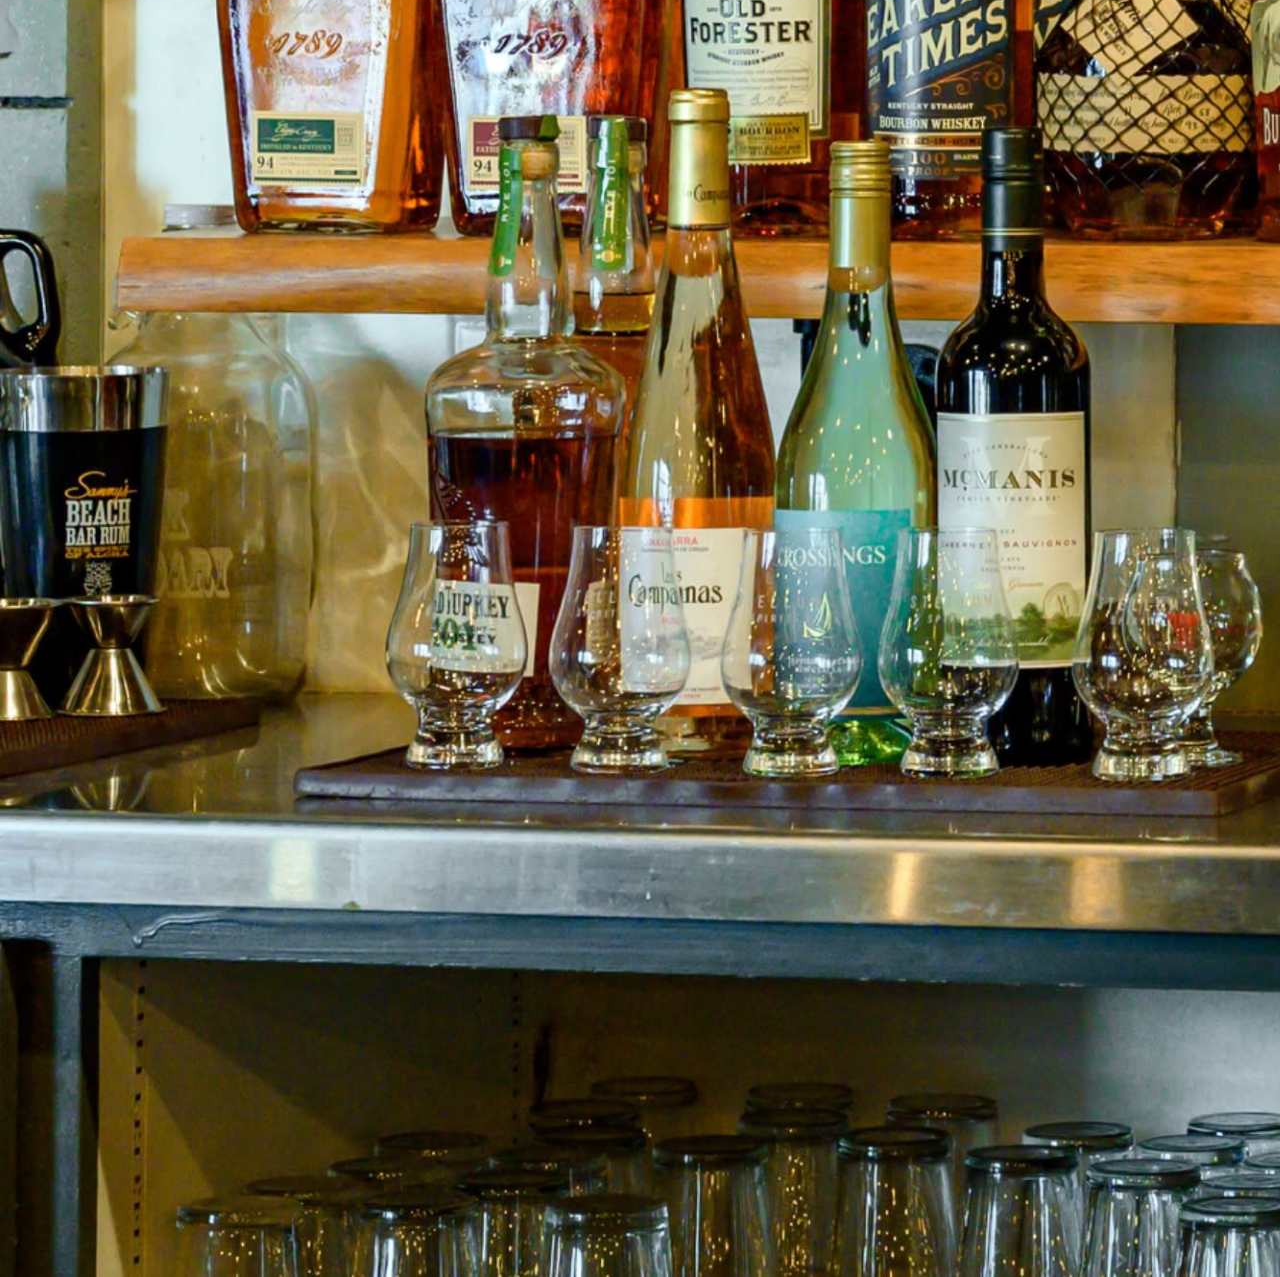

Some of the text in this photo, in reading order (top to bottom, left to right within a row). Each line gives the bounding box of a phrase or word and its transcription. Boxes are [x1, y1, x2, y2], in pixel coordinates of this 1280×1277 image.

[690, 17, 811, 44] FORESTER
[266, 28, 344, 57] 1789
[930, 102, 974, 111] STRAIGHT
[879, 115, 986, 130] BOURBON WHISKEY
[256, 155, 274, 170] 94
[473, 159, 493, 173] 94
[65, 499, 131, 527] BEACH
[65, 525, 131, 548] BAR RUM
[1003, 538, 1077, 548] SAUVIGNON
